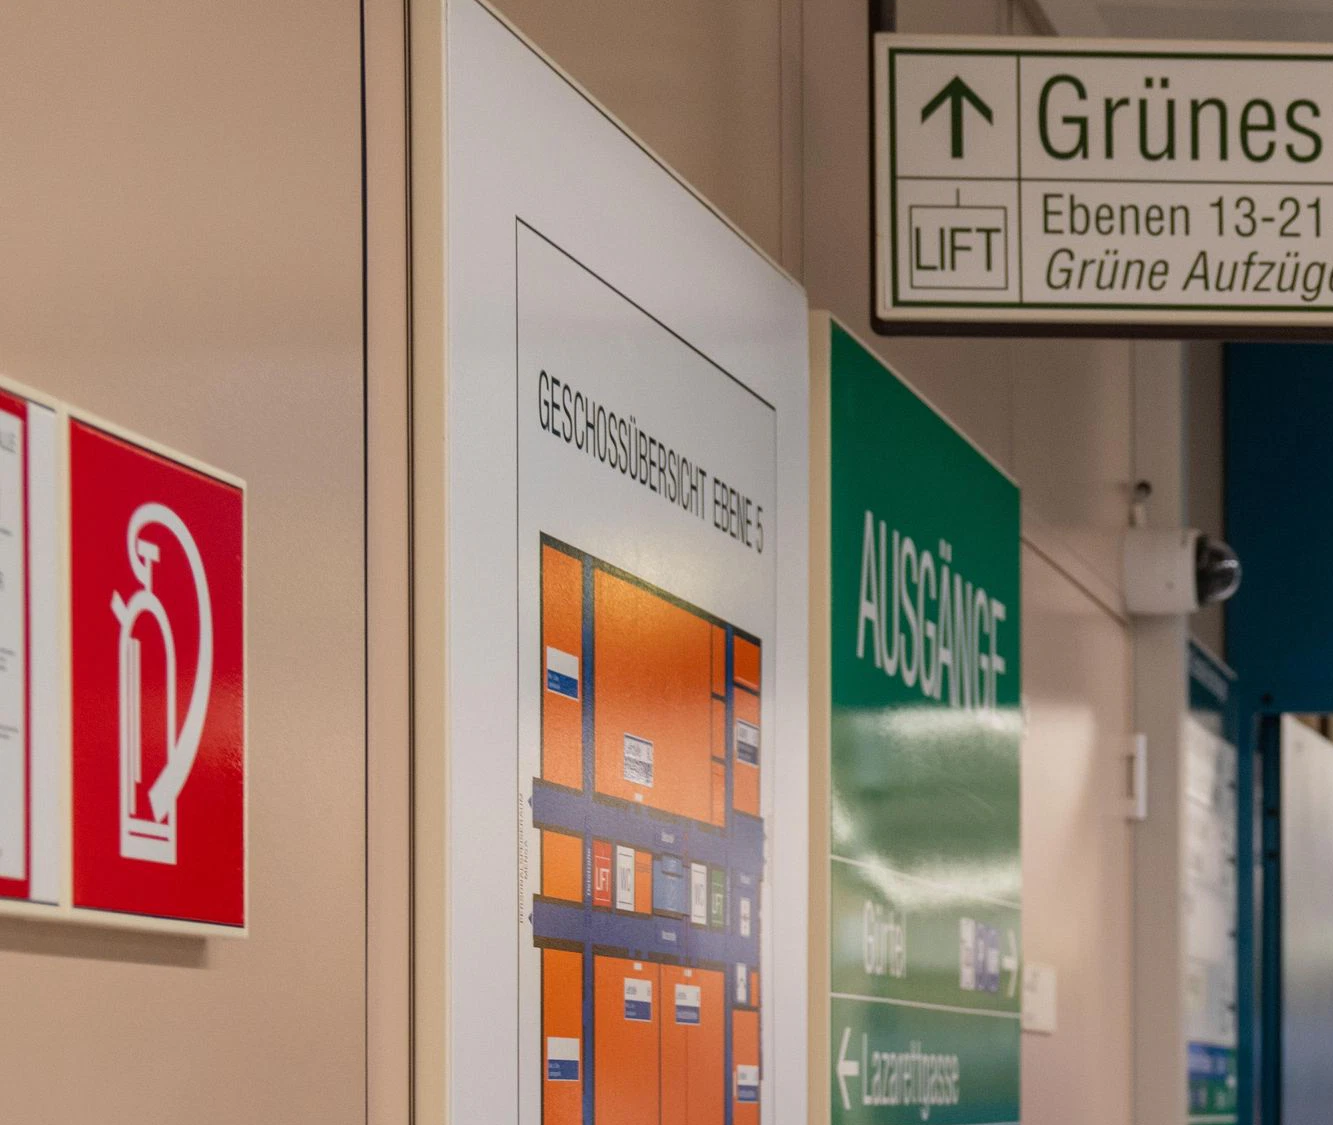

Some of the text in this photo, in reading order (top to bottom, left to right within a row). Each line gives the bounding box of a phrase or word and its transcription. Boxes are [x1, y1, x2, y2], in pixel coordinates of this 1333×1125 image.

[1038, 74, 1323, 163] Grünes
[914, 226, 1002, 272] LIFT
[1043, 193, 1323, 239] Ebenen 13-21
[1045, 246, 1170, 292] Grüne
[538, 369, 764, 554] GESCHOSSÜBERSICHT EBENE 5
[856, 509, 1006, 716] AUSGÄNGE
[863, 899, 907, 979] Gürtel
[862, 1032, 960, 1121] Lazarettgasse
